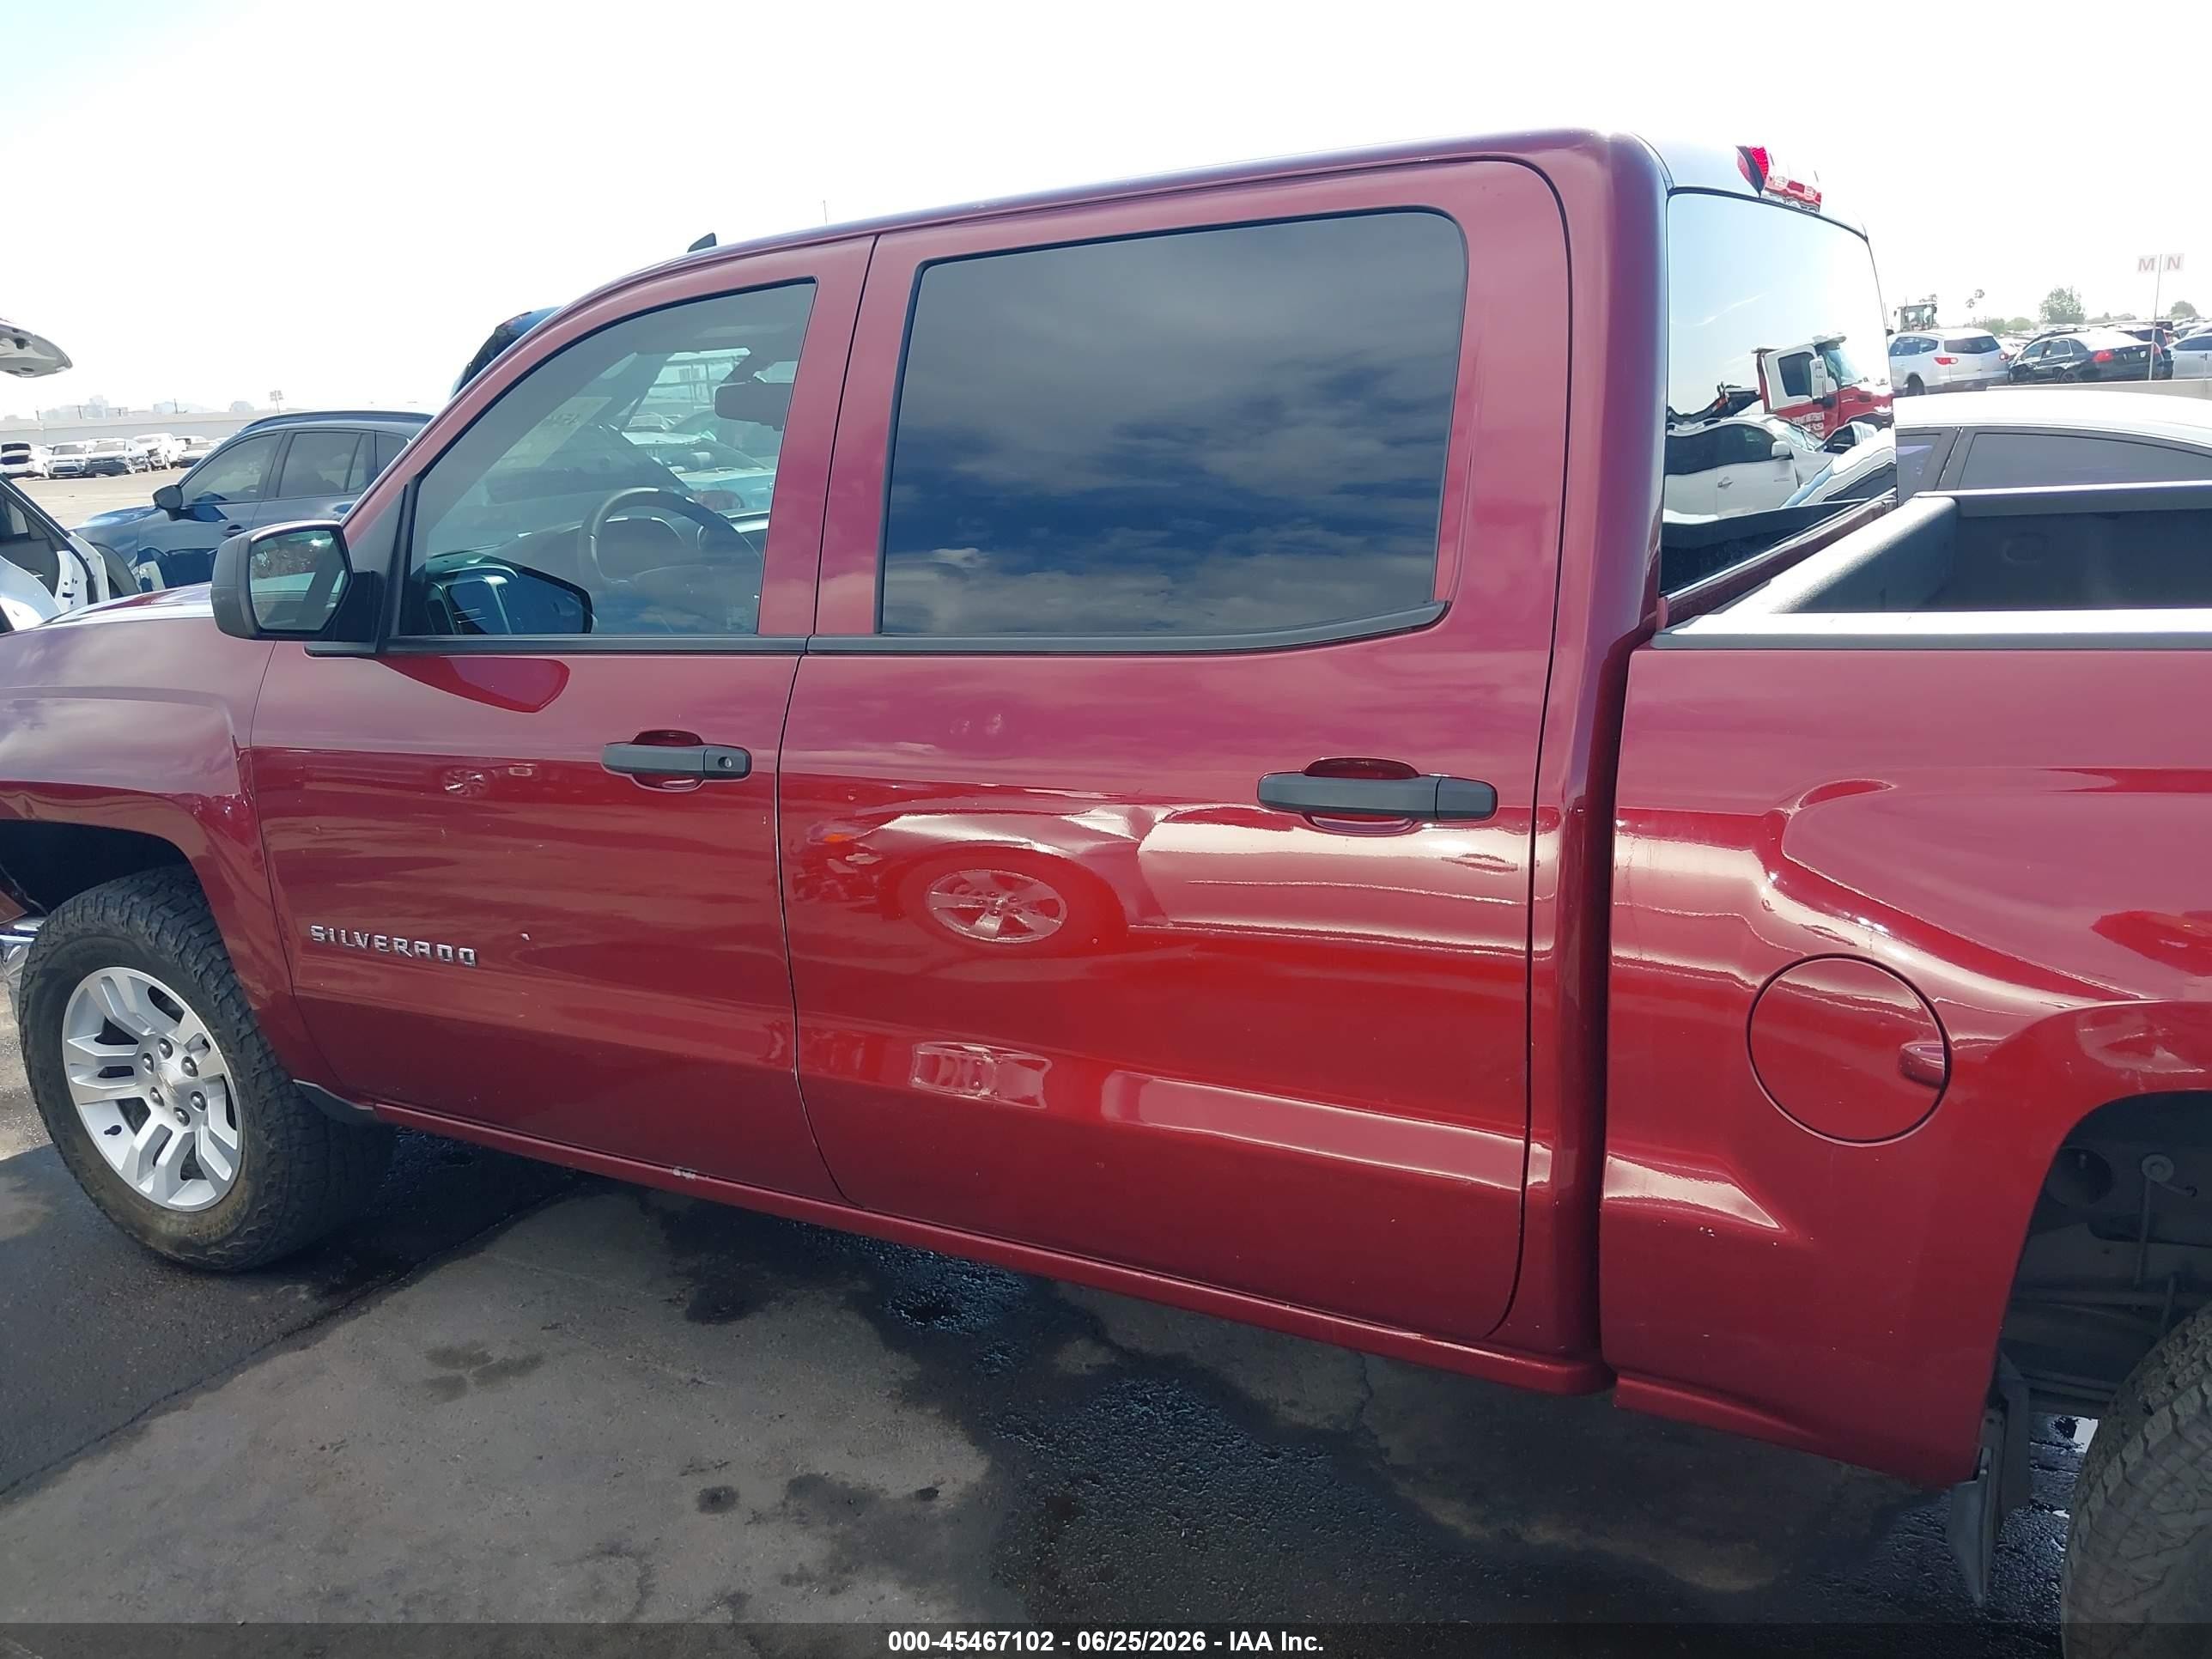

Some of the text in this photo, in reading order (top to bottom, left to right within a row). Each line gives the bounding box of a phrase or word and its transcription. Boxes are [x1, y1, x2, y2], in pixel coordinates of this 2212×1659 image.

[2138, 256, 2181, 271] M N
[310, 925, 477, 967] SILVERADO
